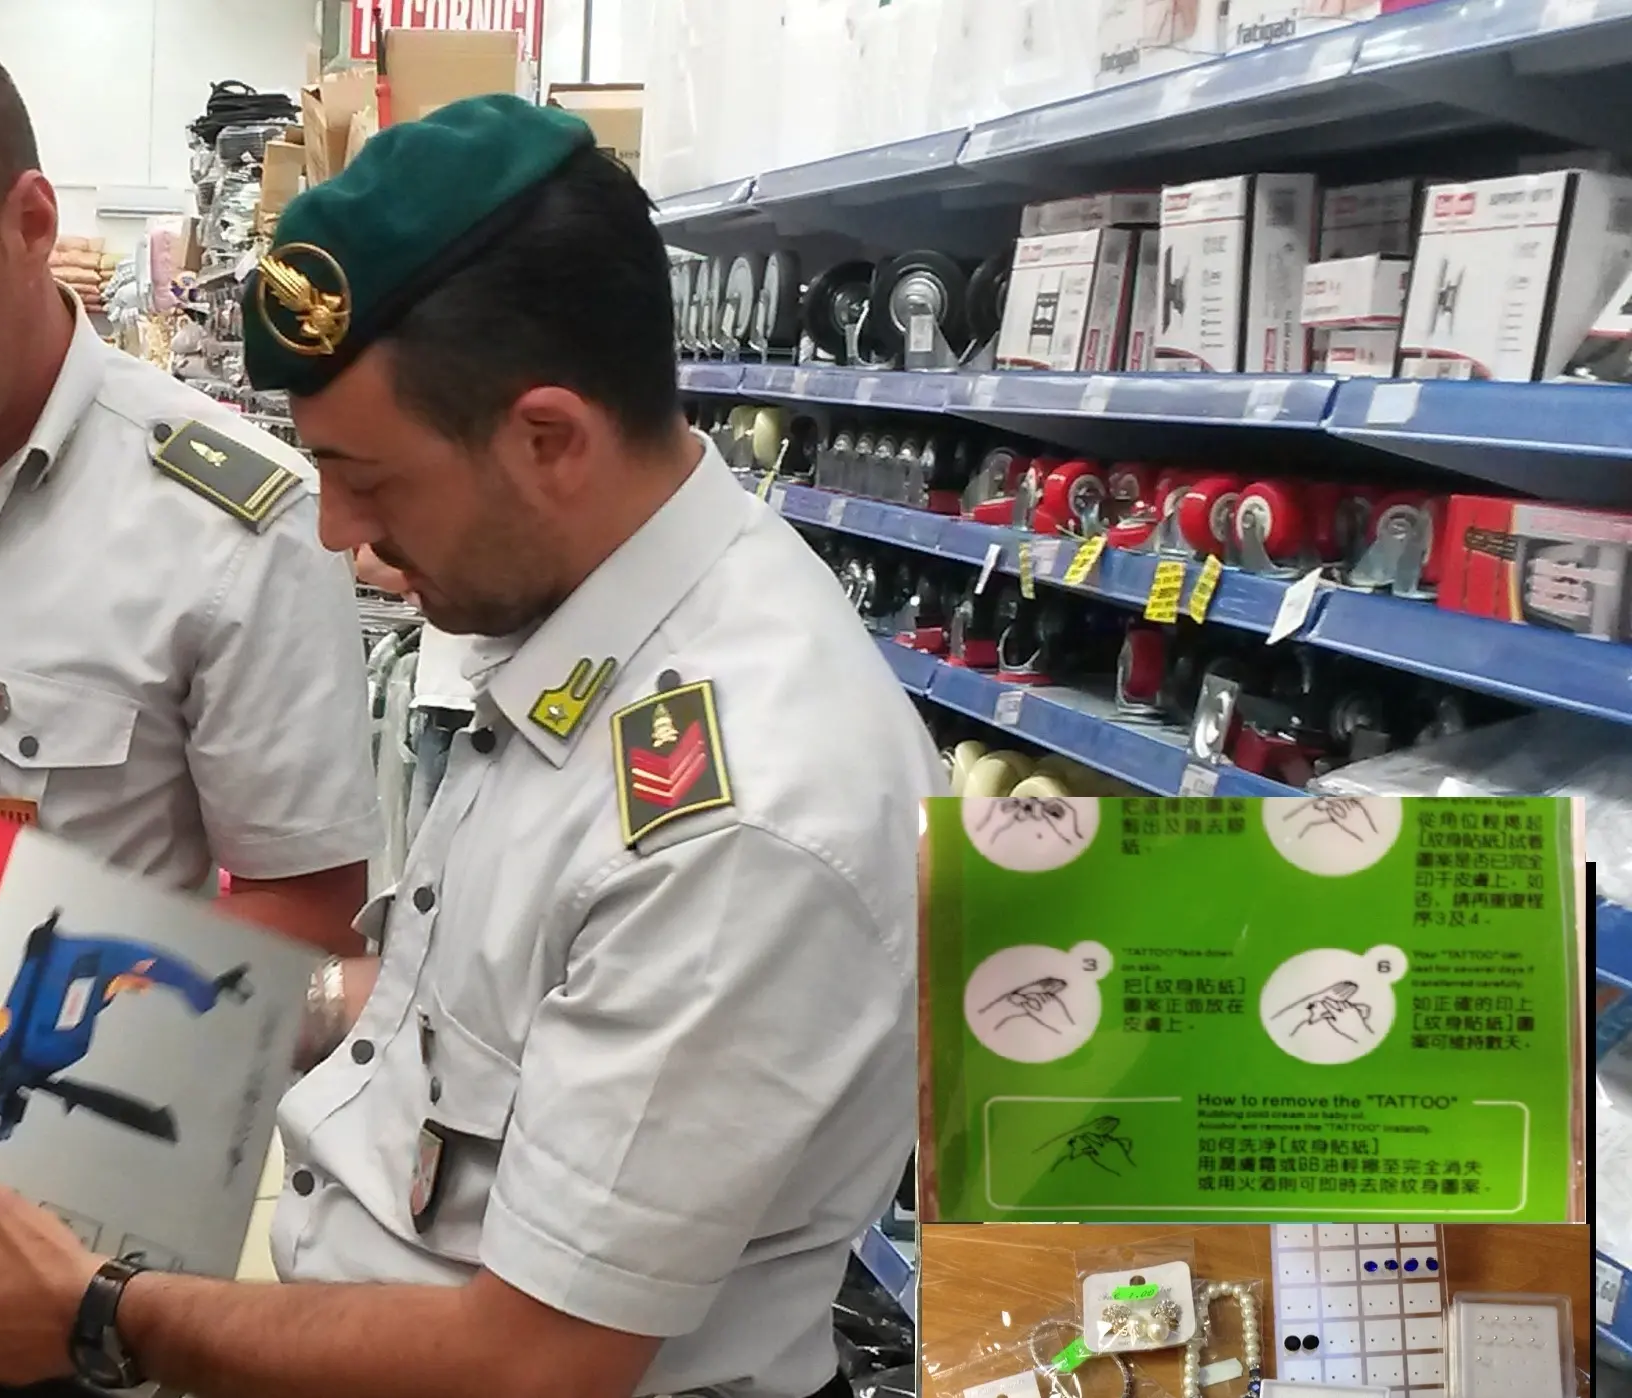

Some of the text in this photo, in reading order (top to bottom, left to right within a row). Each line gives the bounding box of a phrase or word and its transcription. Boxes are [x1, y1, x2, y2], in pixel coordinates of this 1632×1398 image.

[1082, 958, 1098, 972] 3
[1377, 960, 1391, 973] 6
[1197, 1093, 1458, 1110] How to remove the "TATTOO"
